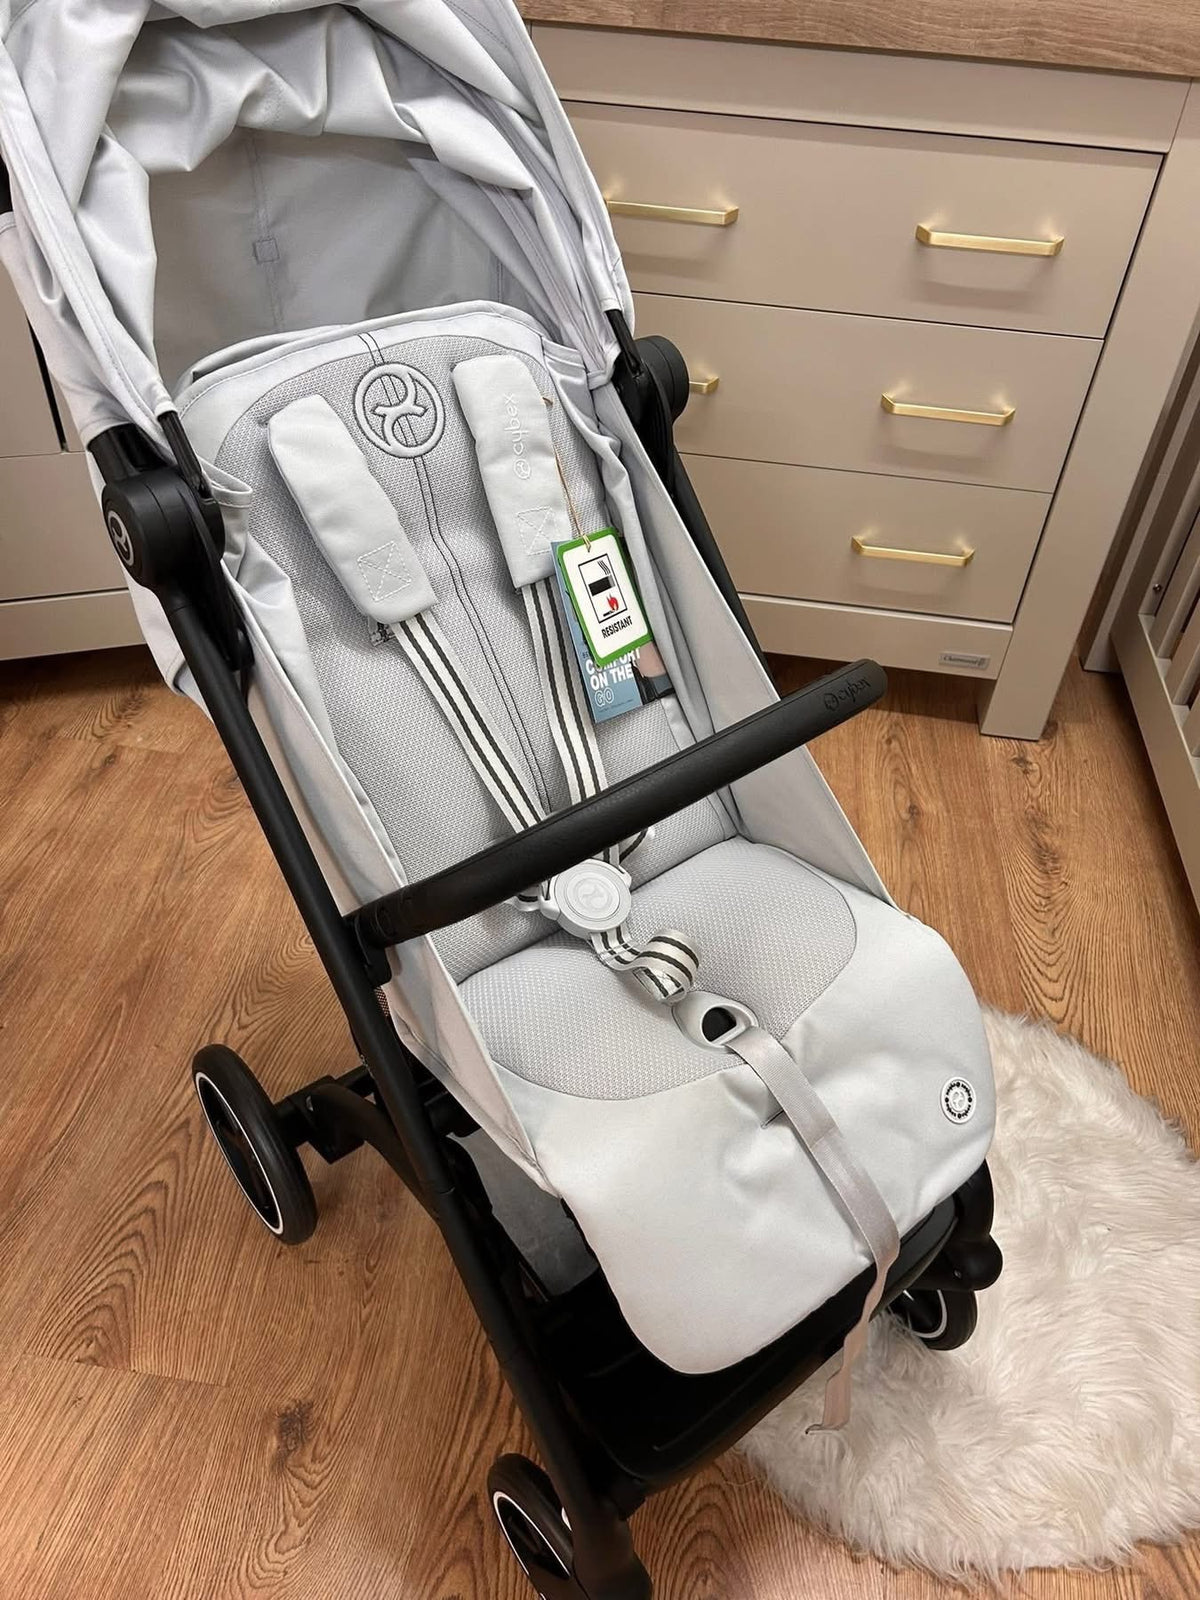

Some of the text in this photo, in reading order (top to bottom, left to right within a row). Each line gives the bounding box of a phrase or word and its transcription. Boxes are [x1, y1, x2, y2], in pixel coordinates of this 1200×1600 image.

[502, 392, 529, 456] cybex
[601, 615, 633, 639] RESISTANT
[590, 663, 634, 691] ON THE
[594, 686, 615, 708] GO
